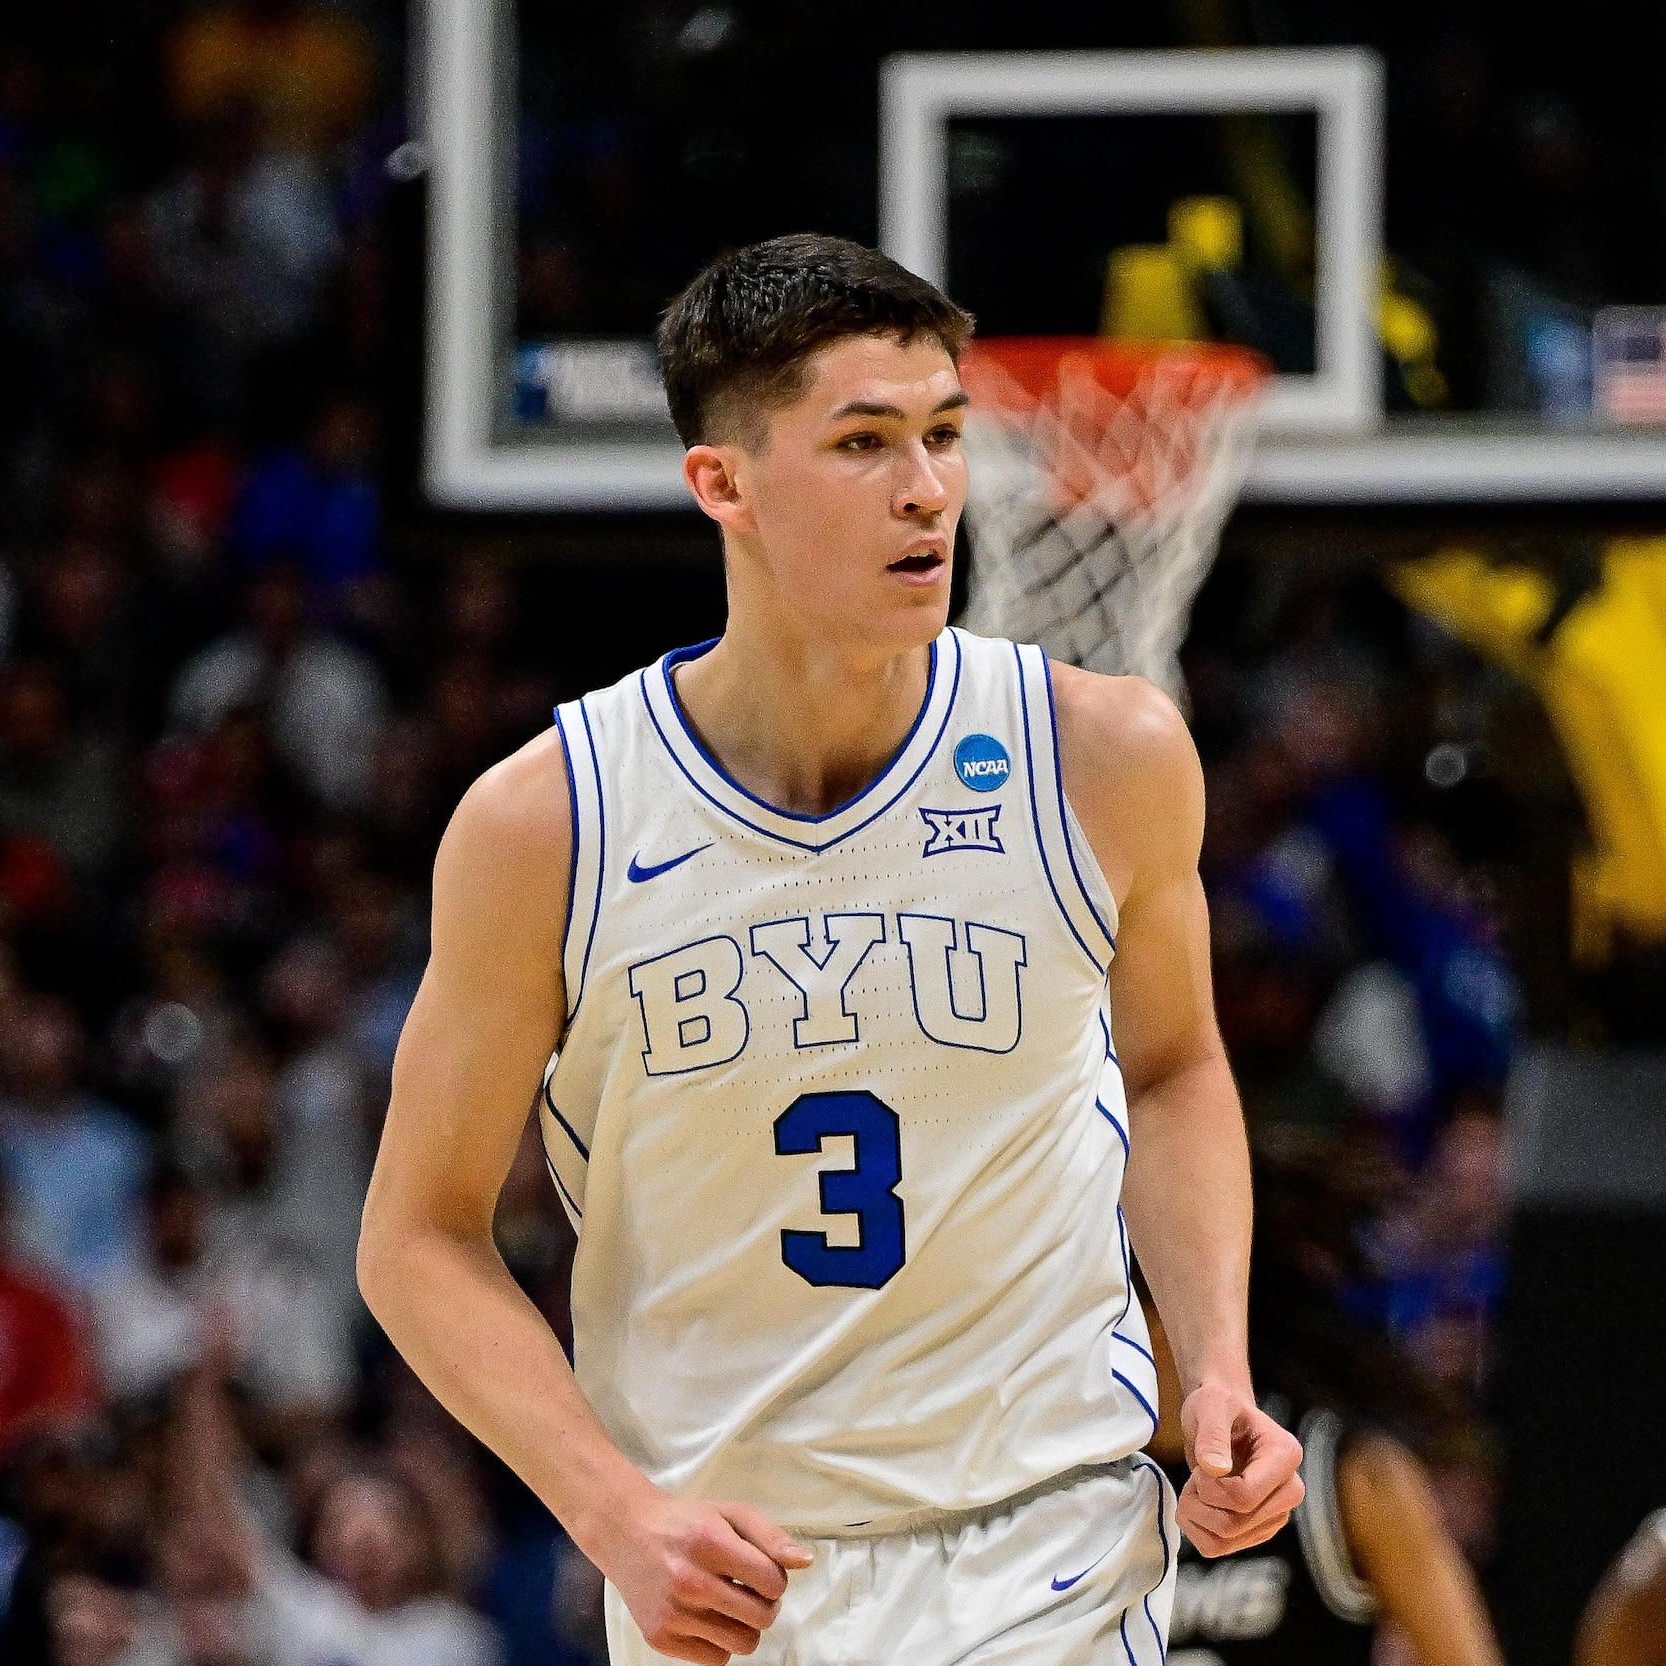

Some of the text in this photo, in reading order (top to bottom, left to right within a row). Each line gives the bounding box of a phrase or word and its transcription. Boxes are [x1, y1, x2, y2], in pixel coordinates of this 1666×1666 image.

[962, 758, 1010, 778] NCAA
[628, 912, 1027, 1077] BYU
[773, 1090, 906, 1290] 3
